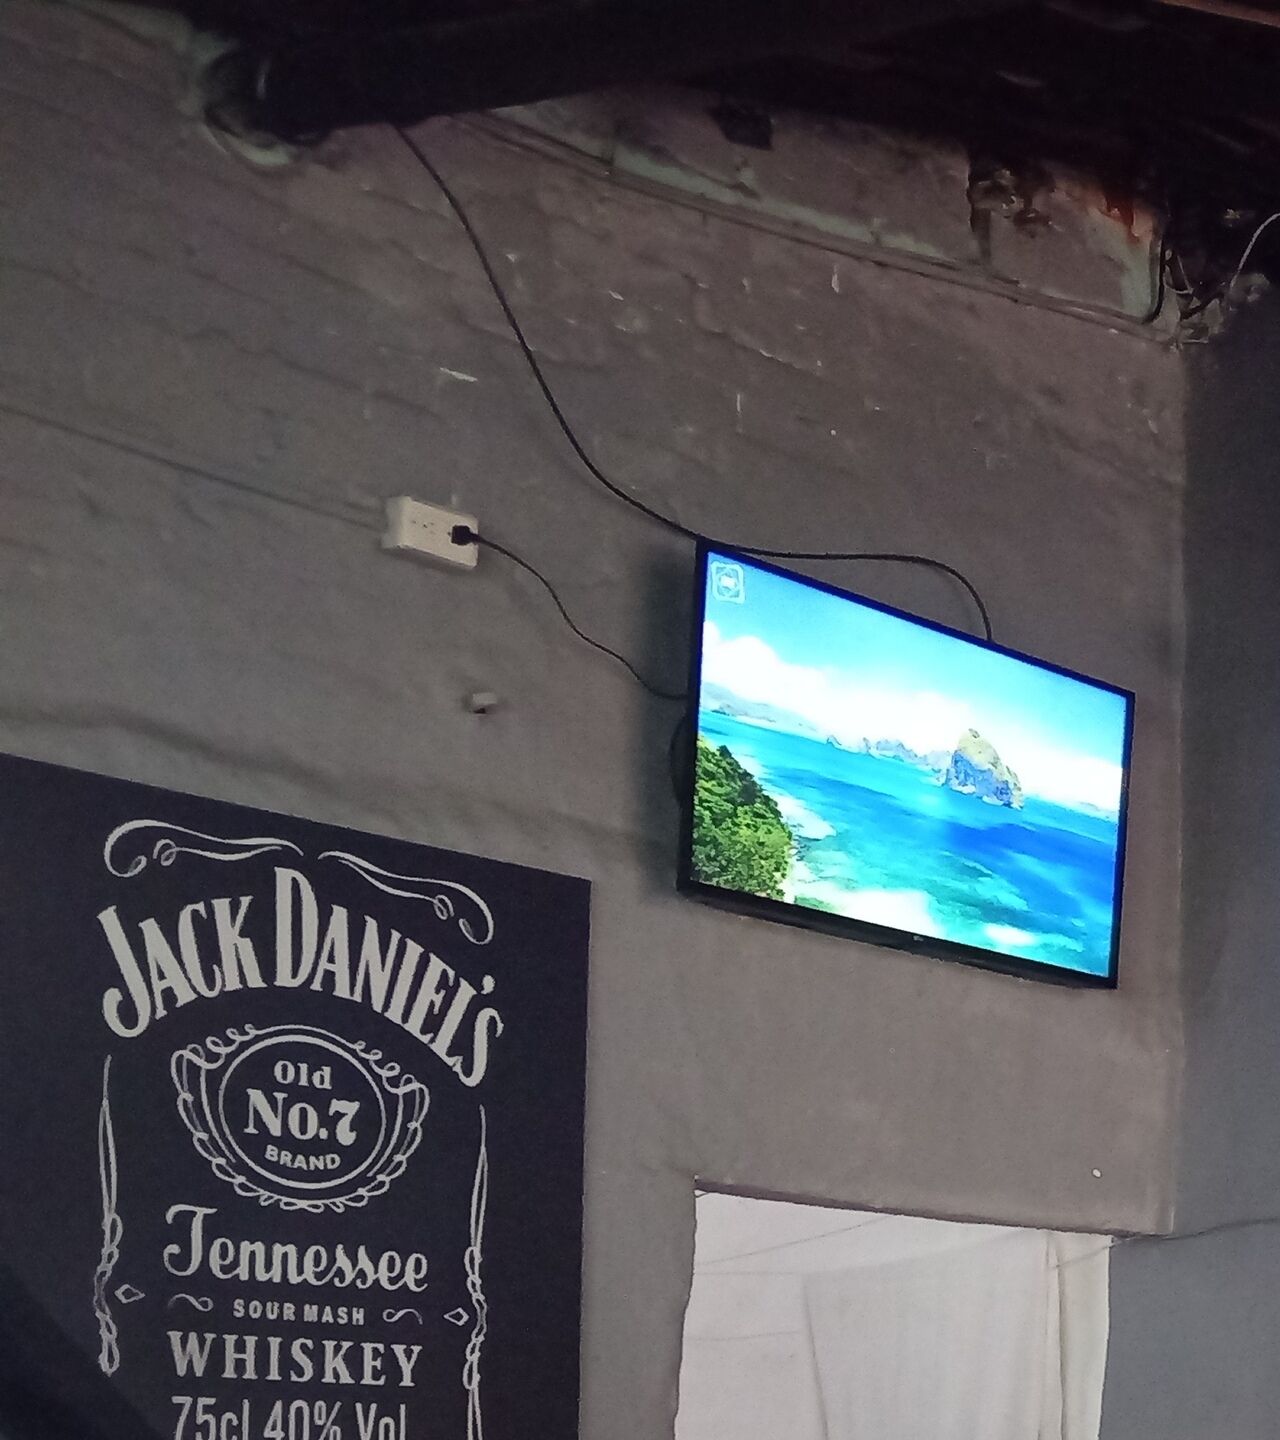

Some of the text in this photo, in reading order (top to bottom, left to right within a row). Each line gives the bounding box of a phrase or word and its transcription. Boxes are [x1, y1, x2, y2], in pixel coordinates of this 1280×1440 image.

[97, 866, 504, 1087] JACK DANIEL'S
[274, 1060, 332, 1089] Old
[265, 1145, 341, 1171] BRAND
[163, 1204, 429, 1292] Tennessee
[233, 1299, 365, 1326] SOUR MASH
[167, 1331, 423, 1387] WHISKEY
